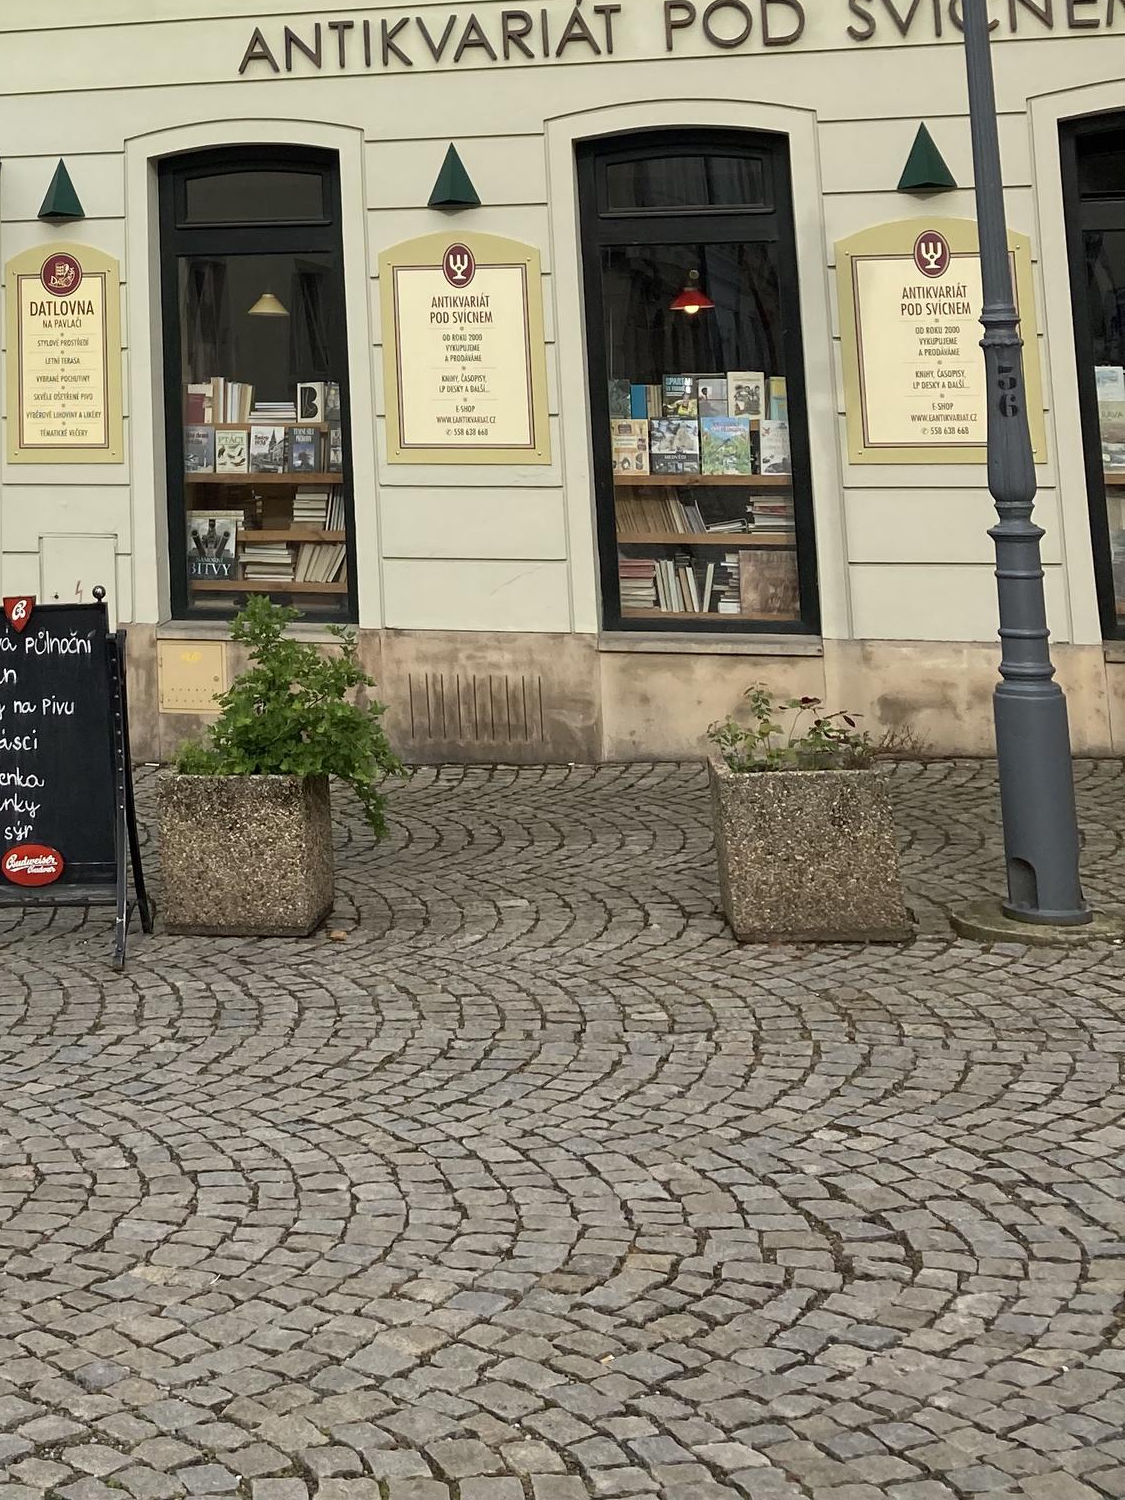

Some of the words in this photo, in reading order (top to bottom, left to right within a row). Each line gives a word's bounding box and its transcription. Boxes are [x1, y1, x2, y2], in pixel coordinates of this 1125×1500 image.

[902, 282, 968, 300] ANTIKVARIÁT
[29, 300, 95, 316] DATLOVNA
[431, 293, 490, 309] ANTIKVARIÁT
[901, 303, 923, 316] POD
[926, 300, 971, 316] SVÍCNEM
[42, 319, 53, 328] NA
[430, 311, 450, 324] POD
[452, 308, 493, 323] SVÍCNEM
[442, 333, 451, 341] OD
[451, 333, 467, 341] ROKU
[915, 327, 924, 335] OD
[926, 326, 943, 335] ROKU
[944, 326, 960, 334] 2000
[919, 337, 958, 346] VYKUPUJEME
[921, 381, 940, 389] DESKY
[930, 427, 943, 435] 558
[13, 697, 36, 714] na
[4, 819, 33, 842] sýr
